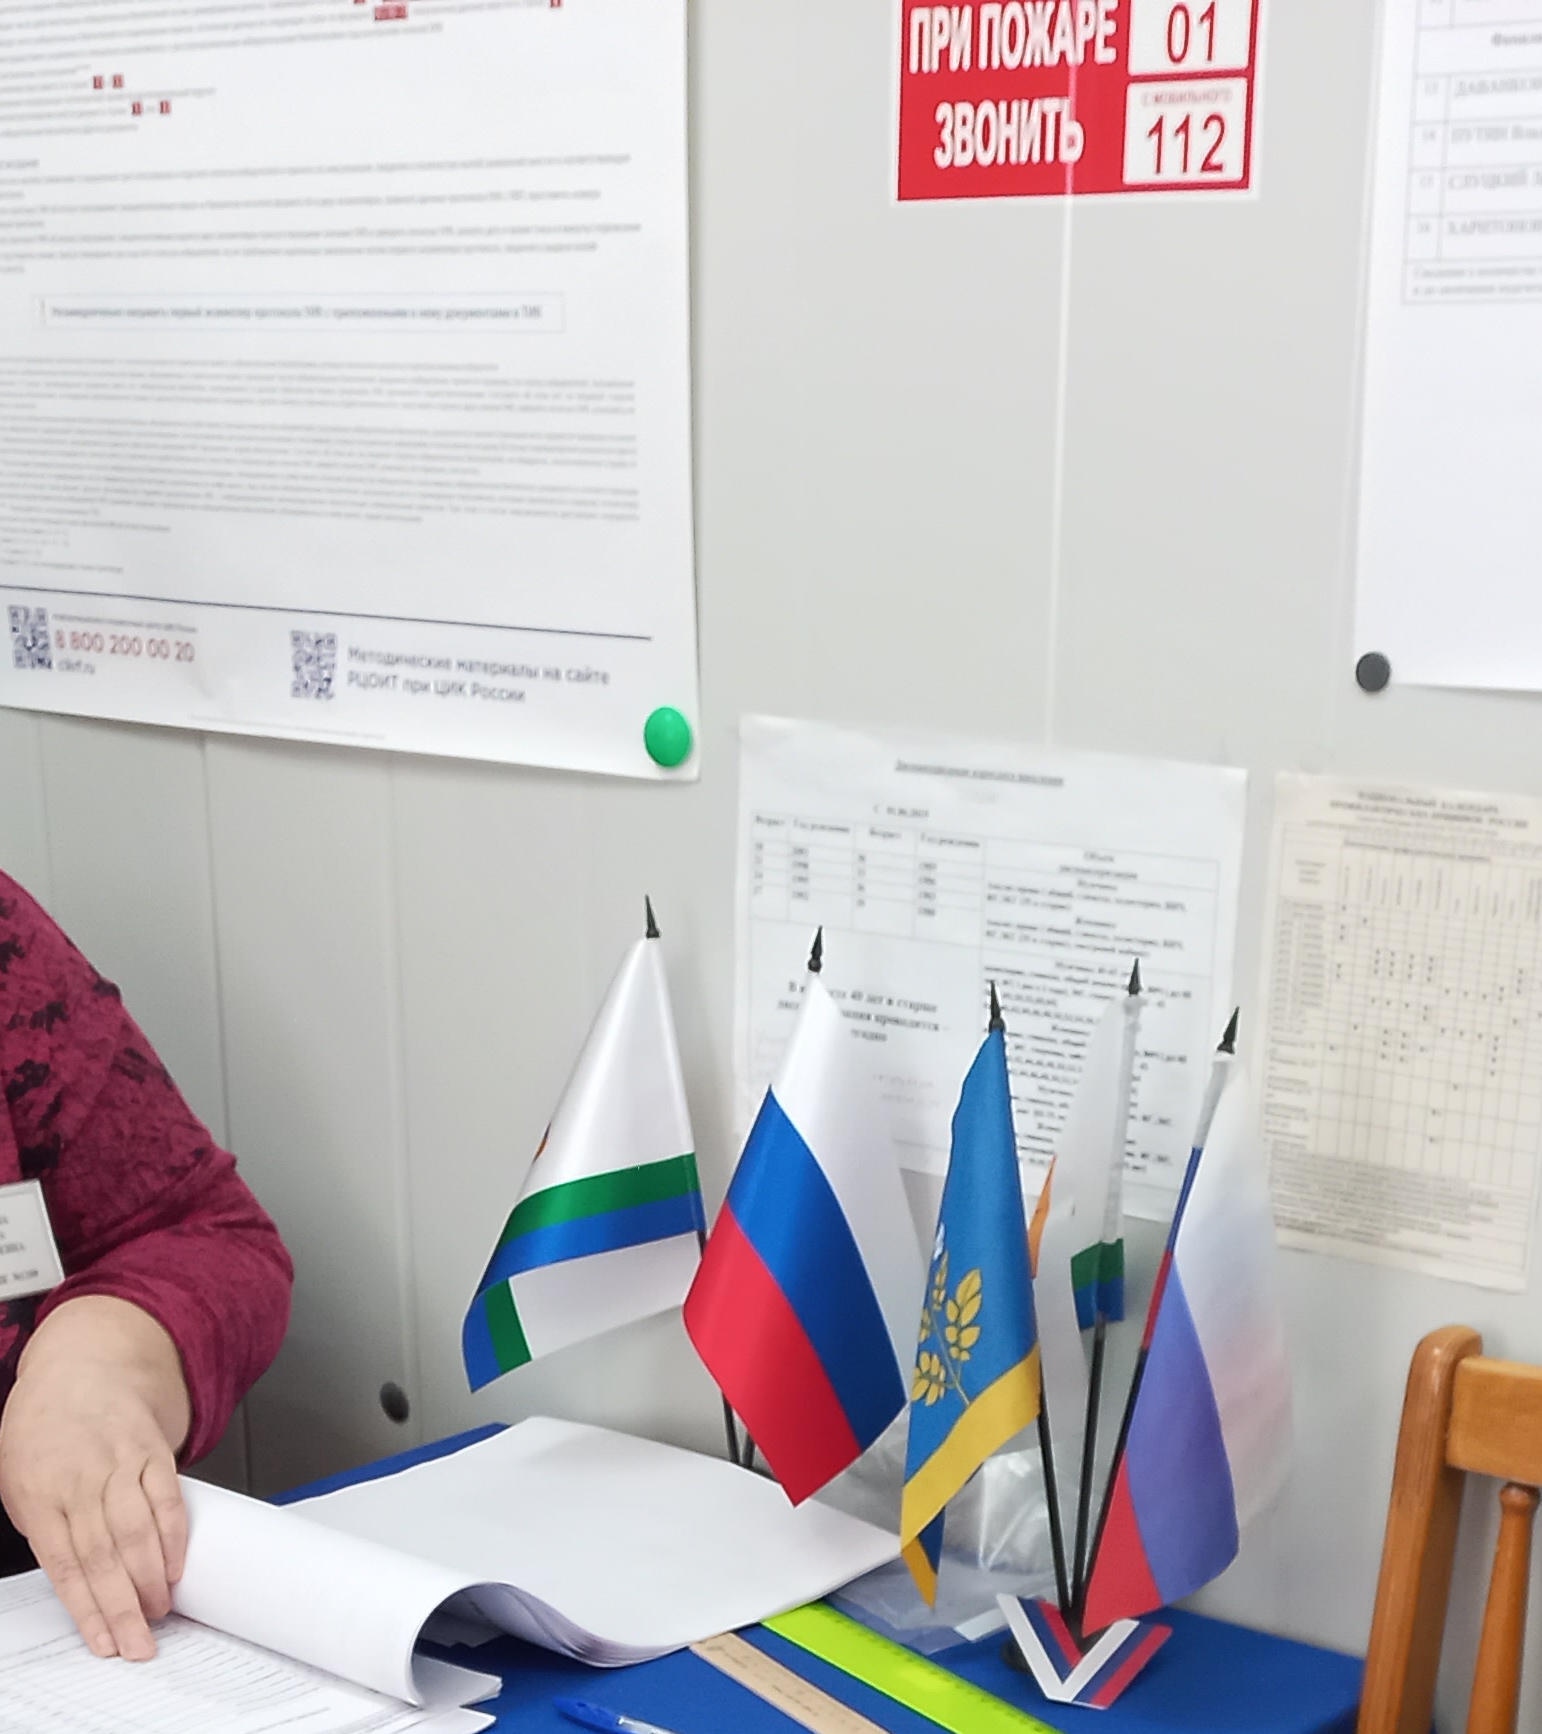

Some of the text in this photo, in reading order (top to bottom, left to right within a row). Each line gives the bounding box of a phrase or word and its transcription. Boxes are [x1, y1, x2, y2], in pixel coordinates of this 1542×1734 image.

[908, 0, 1117, 74] ПРИ ПОЖАРЕ
[1166, 4, 1217, 65] 01
[933, 97, 1085, 169] ЗВОНИТЬ
[1147, 114, 1227, 175] 112
[70, 631, 104, 653] 800
[109, 634, 142, 657] 200
[147, 638, 170, 659] 00
[174, 640, 195, 662] 20
